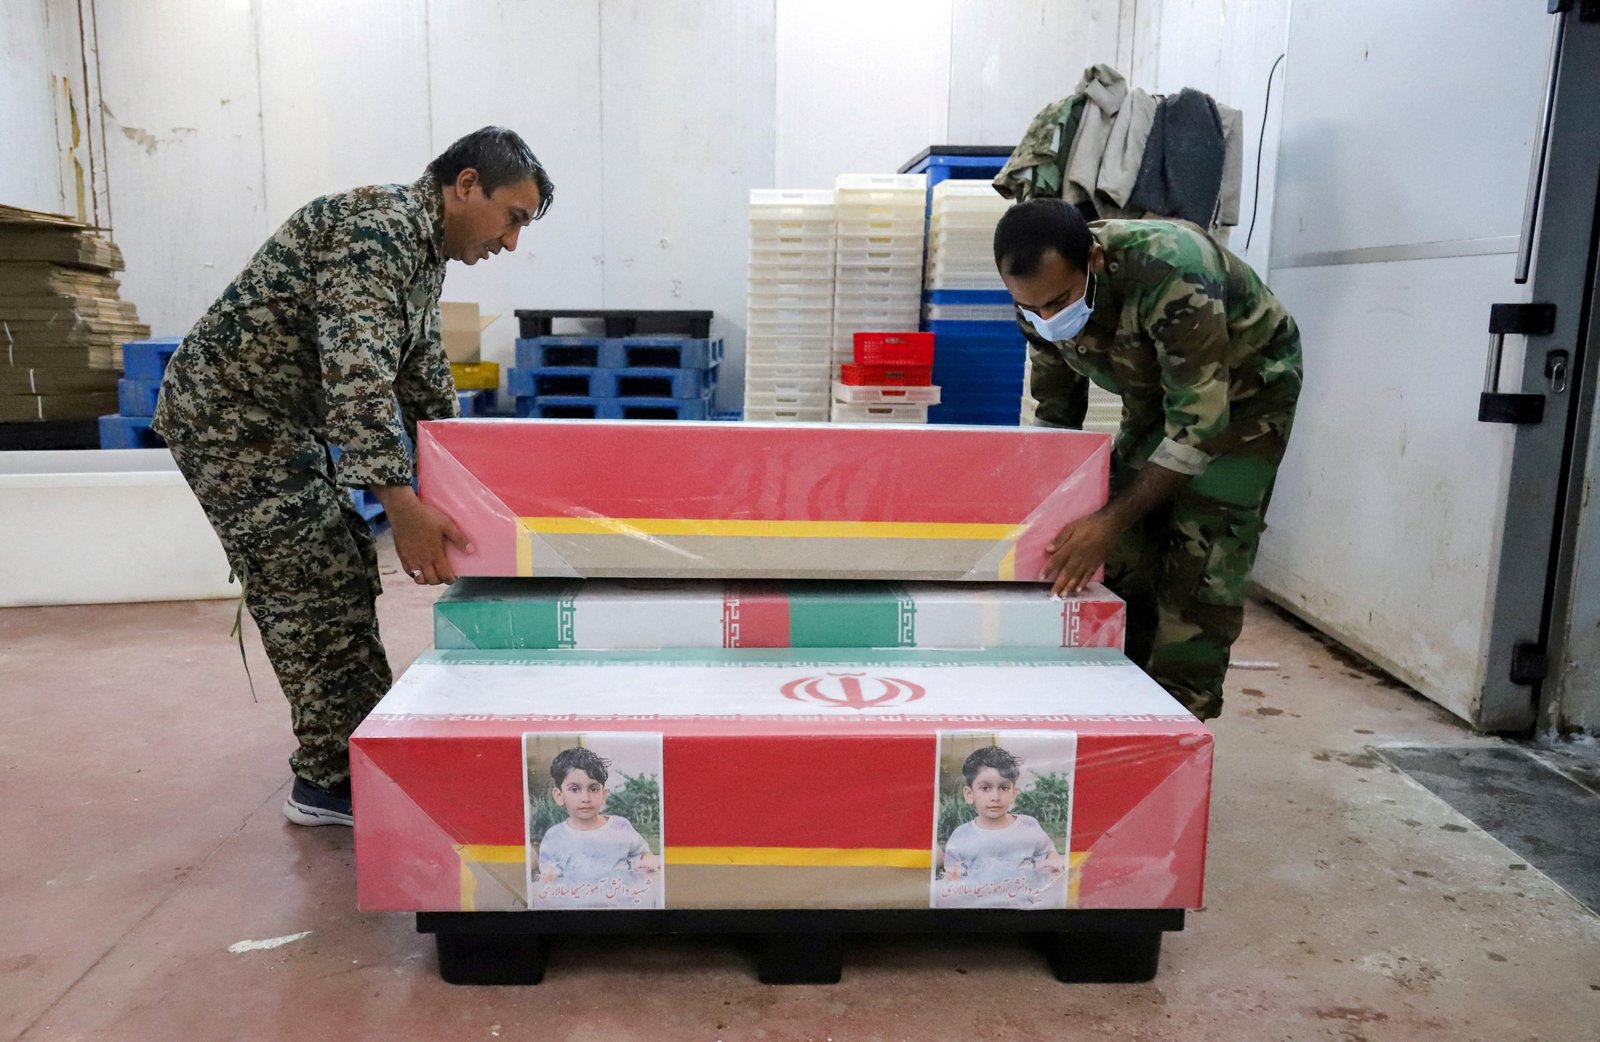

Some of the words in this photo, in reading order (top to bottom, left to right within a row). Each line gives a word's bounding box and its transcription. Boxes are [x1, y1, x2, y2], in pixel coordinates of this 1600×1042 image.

[585, 880, 606, 896] آموز
[605, 878, 629, 899] دانش
[631, 879, 651, 903] شهید
